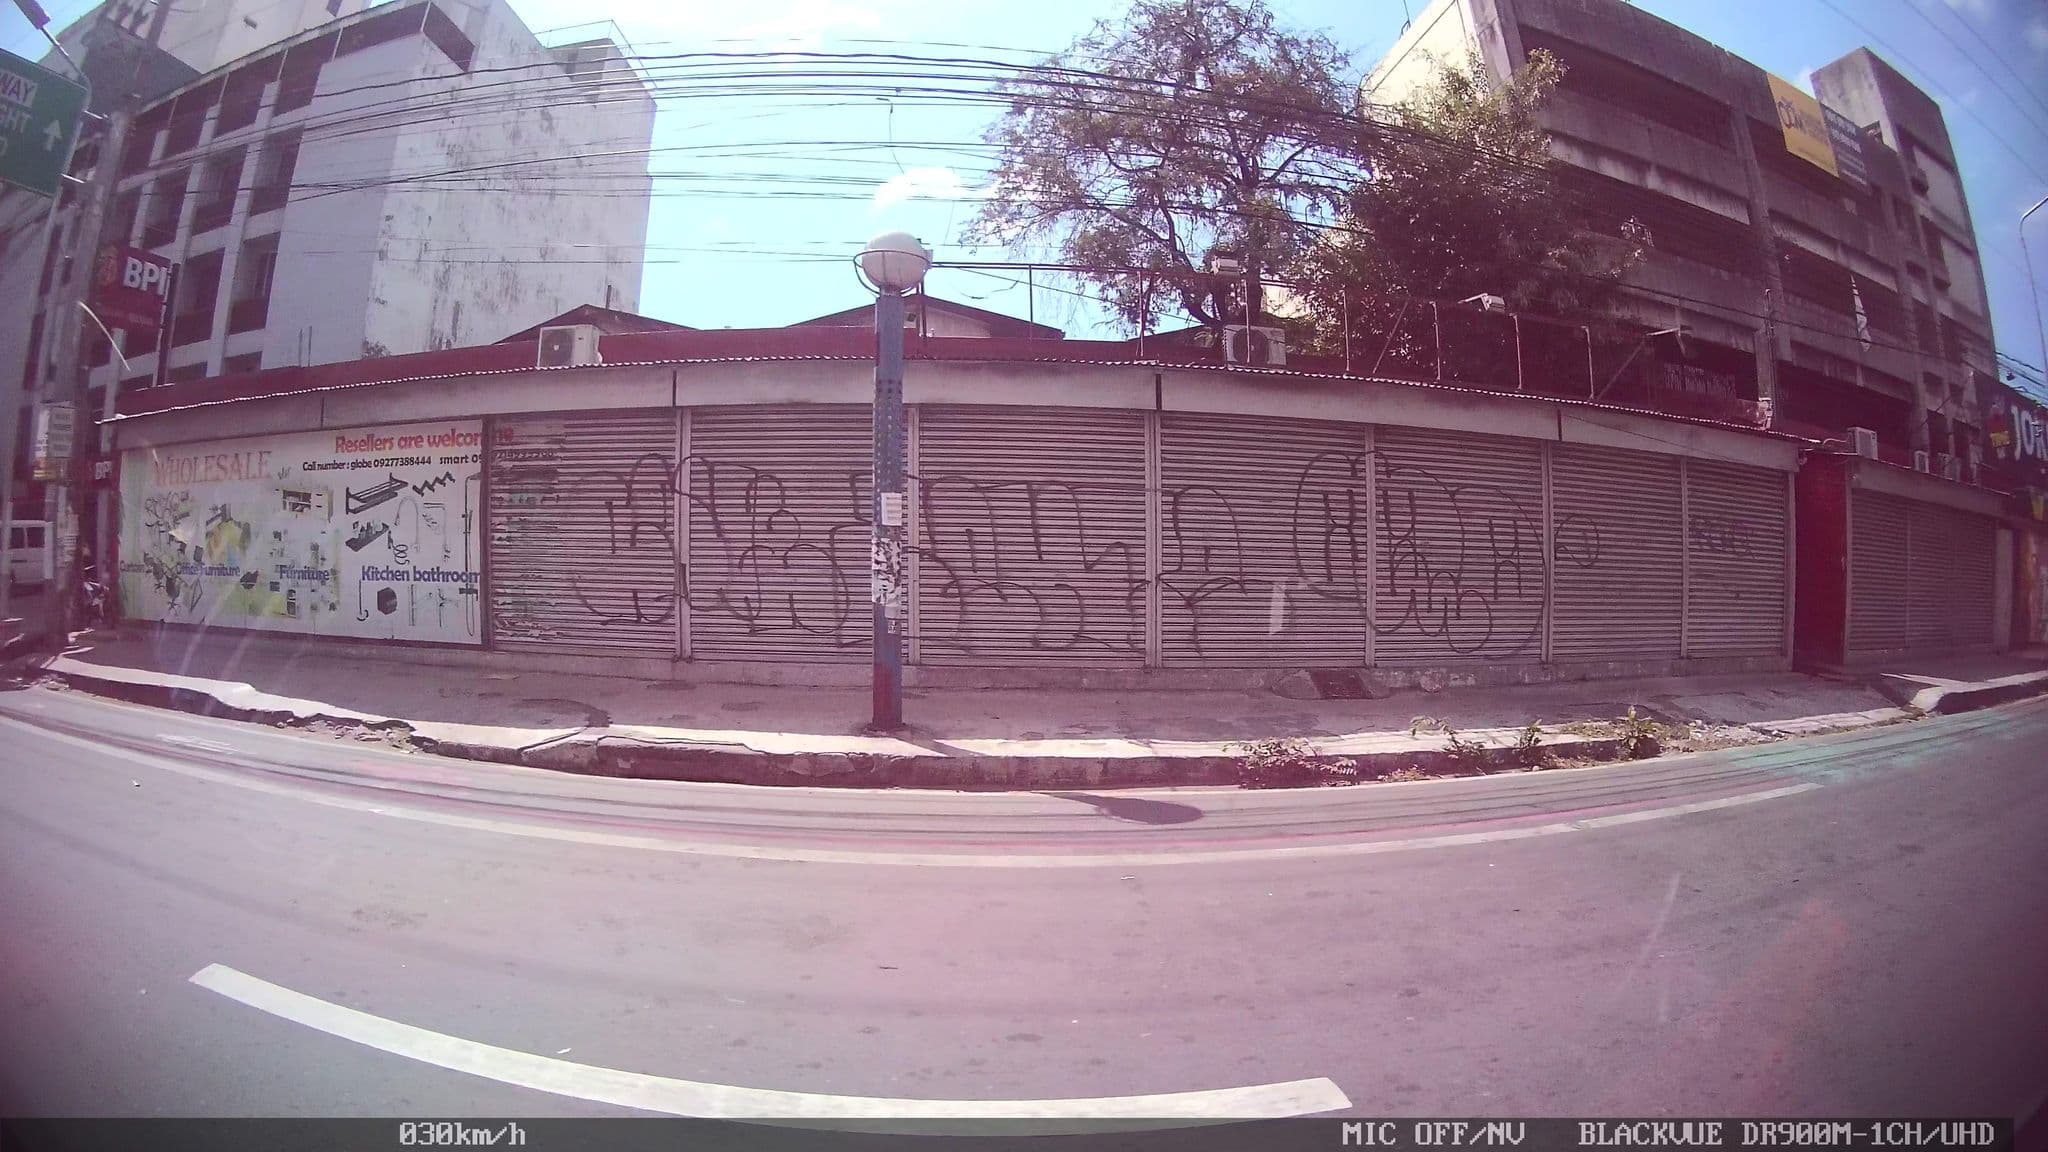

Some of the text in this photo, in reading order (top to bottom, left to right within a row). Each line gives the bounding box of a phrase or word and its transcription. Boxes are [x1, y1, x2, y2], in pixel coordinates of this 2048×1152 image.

[123, 256, 168, 297] BPI
[336, 433, 394, 454] Resellers
[397, 434, 425, 450] are
[152, 450, 273, 486] WHOLESALE
[302, 461, 317, 471] Call
[350, 458, 372, 471] globe
[373, 456, 431, 468] 09277388444
[440, 453, 468, 465] smart
[278, 564, 330, 581] Furniture
[361, 565, 410, 582] Kitchen
